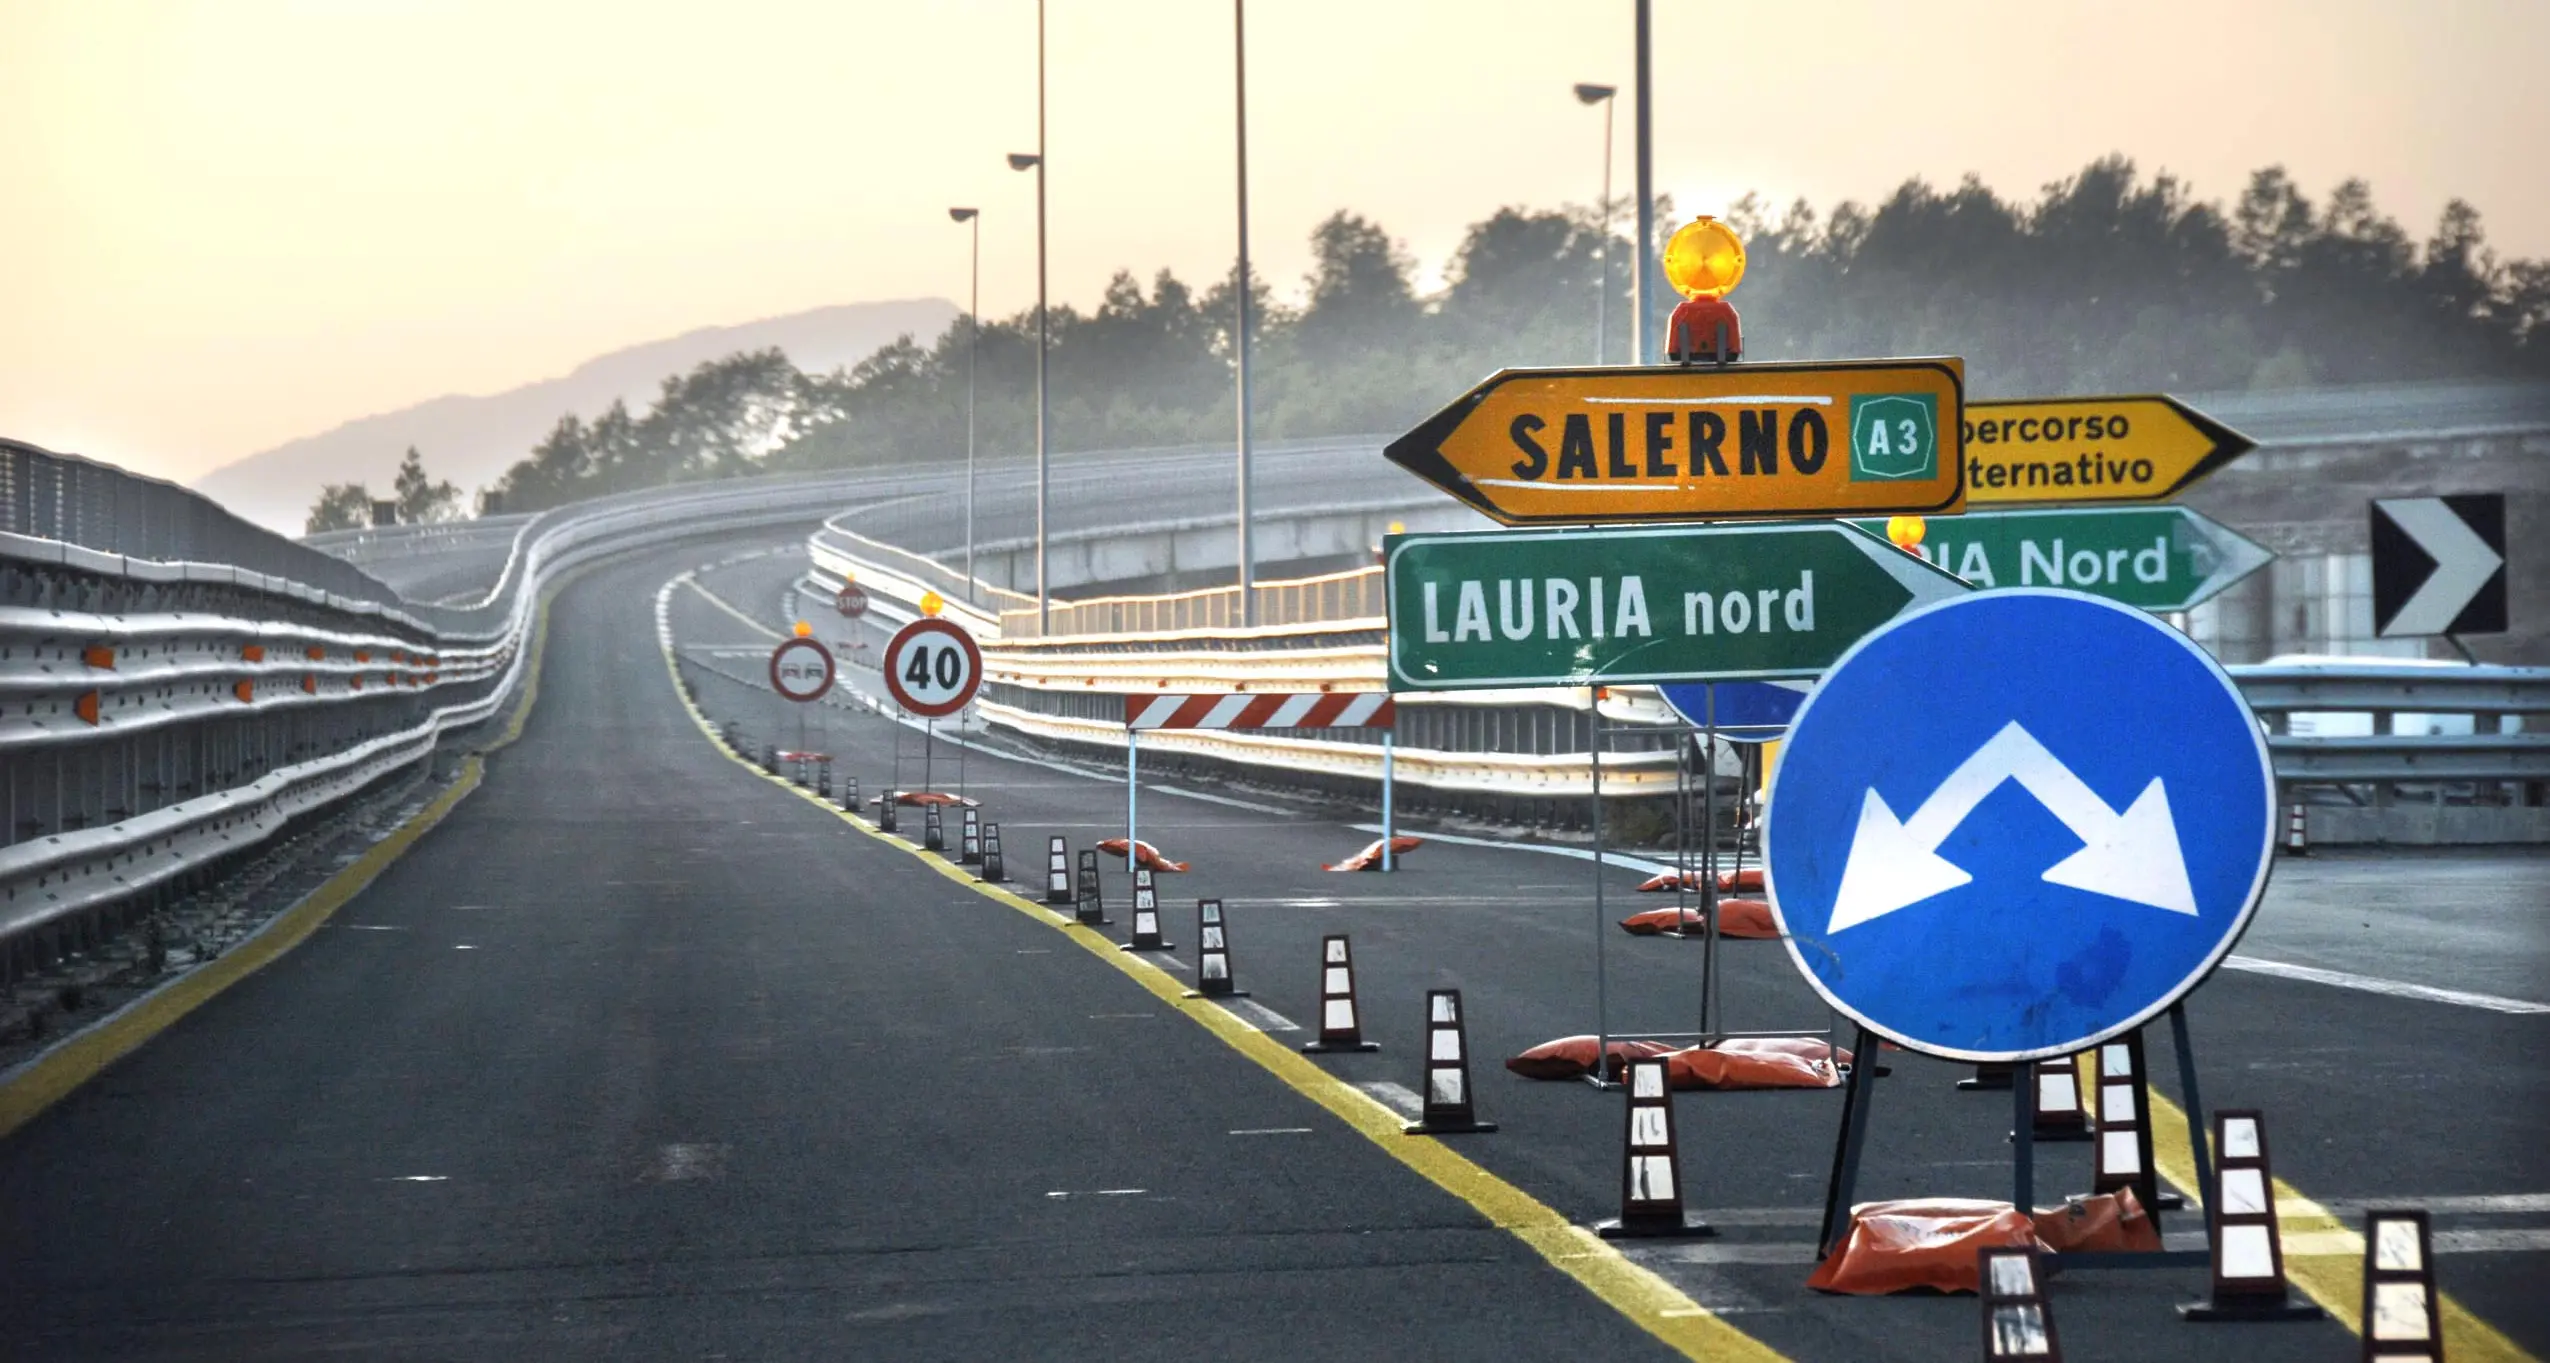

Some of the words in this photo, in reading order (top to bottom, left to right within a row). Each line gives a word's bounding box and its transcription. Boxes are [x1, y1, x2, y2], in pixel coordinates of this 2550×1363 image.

[1509, 407, 1829, 481] SALERNO
[1868, 418, 1918, 456] A3
[1968, 452, 2155, 489] ternativo
[2020, 536, 2168, 586] Nord
[838, 596, 867, 610] STOP
[1423, 575, 1653, 643] LAURIA
[1683, 570, 1815, 637] nord
[904, 645, 962, 690] 40
